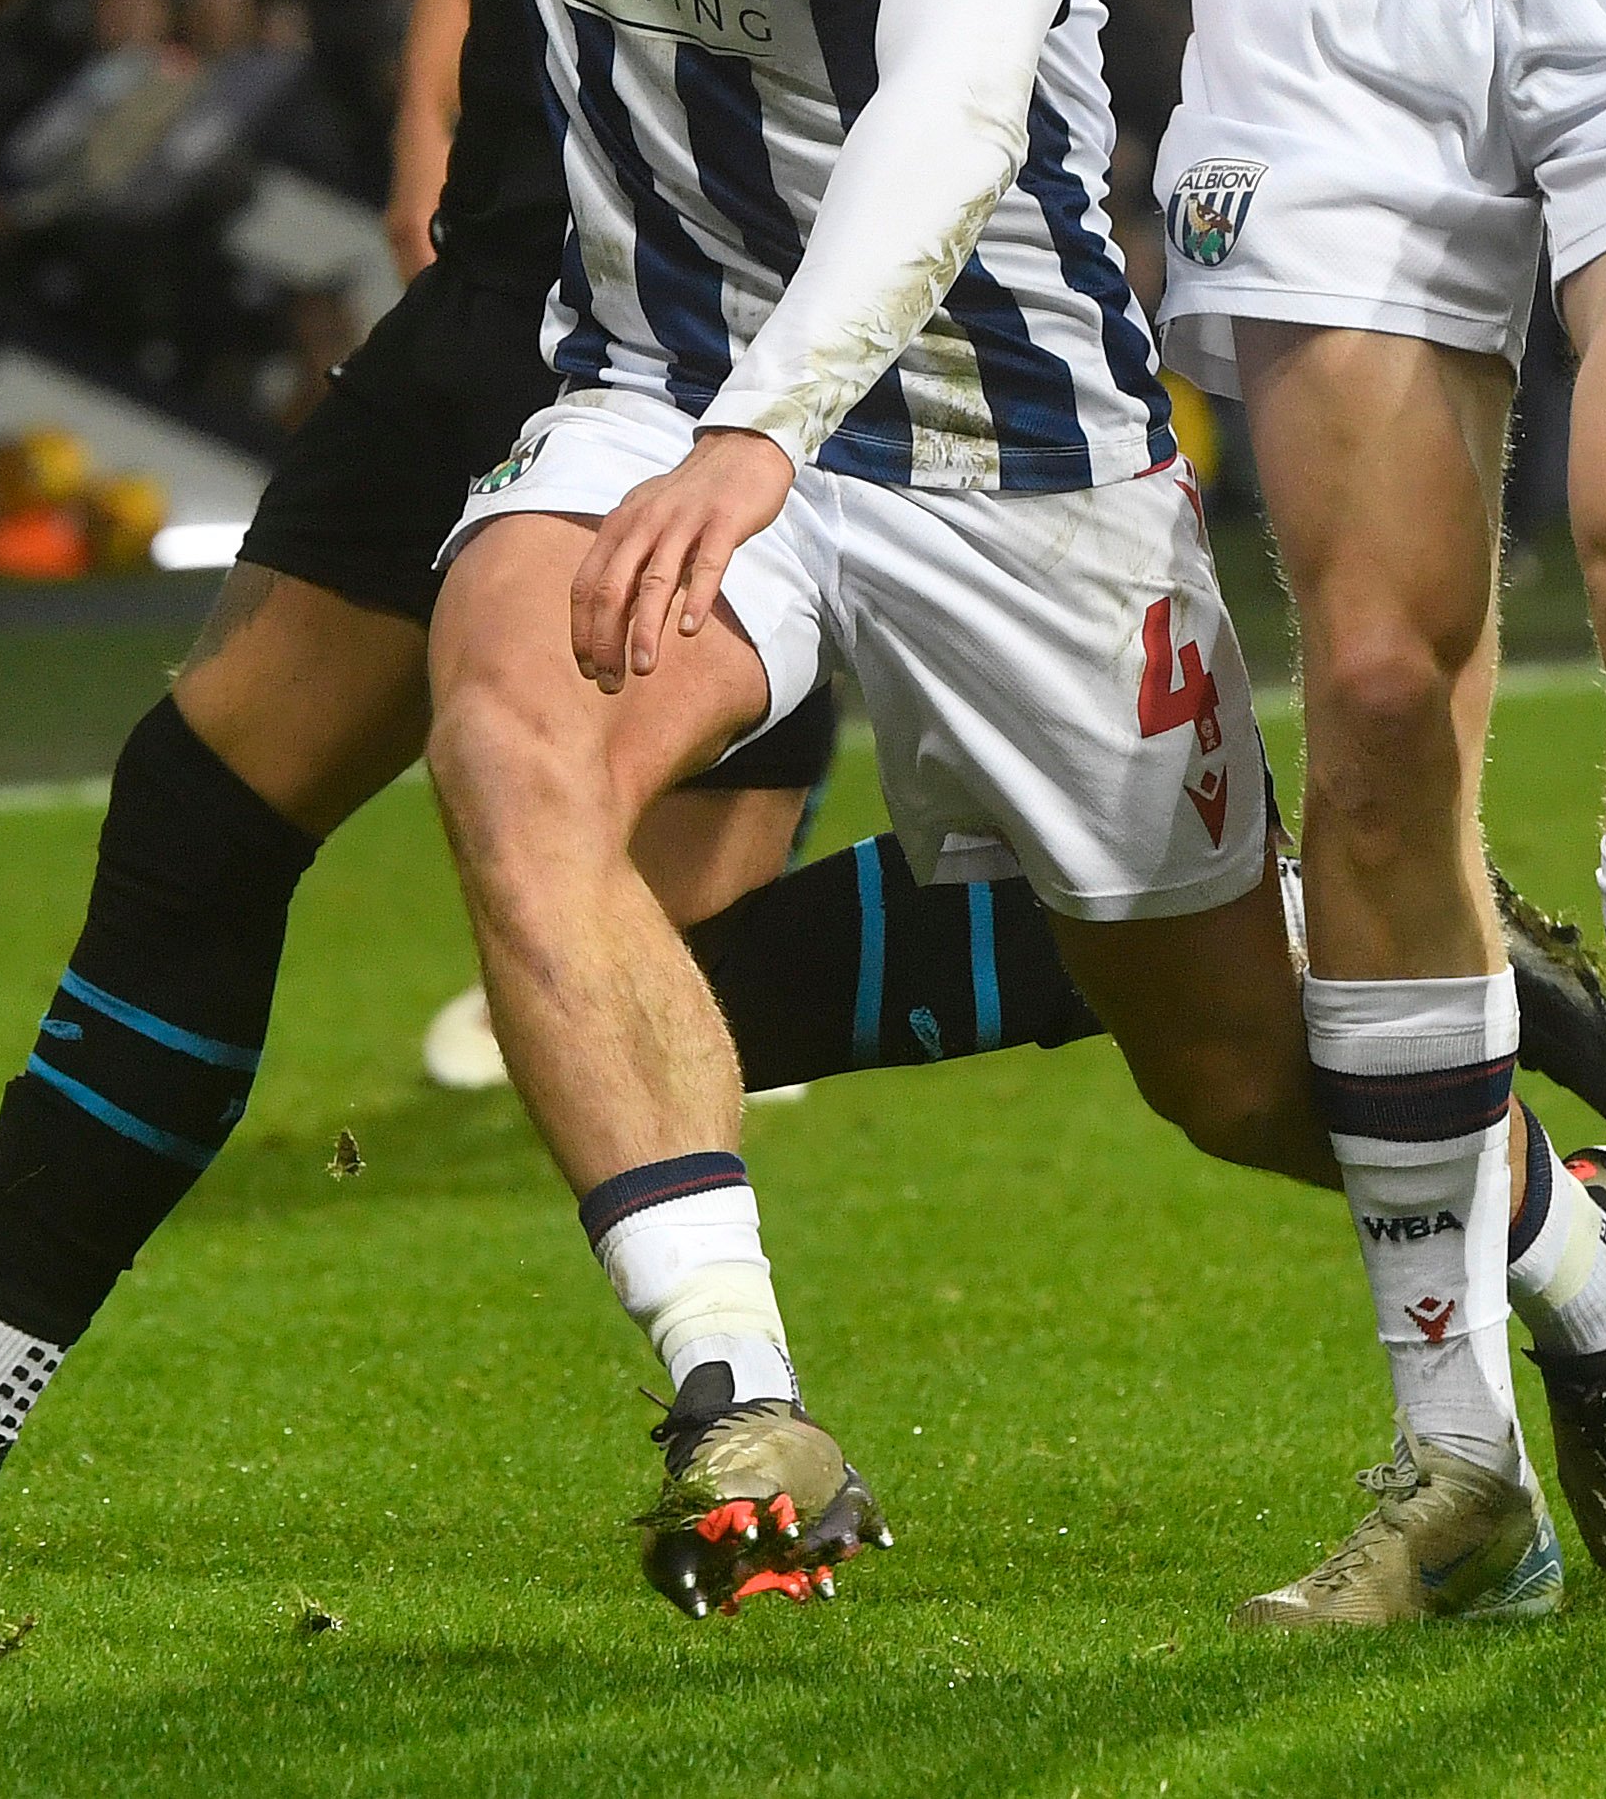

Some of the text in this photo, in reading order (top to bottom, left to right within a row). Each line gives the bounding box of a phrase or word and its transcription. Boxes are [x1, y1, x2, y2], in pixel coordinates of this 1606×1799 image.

[1177, 171, 1259, 191] ALBION
[1136, 595, 1221, 757] 4
[1361, 1210, 1465, 1244] WBA
